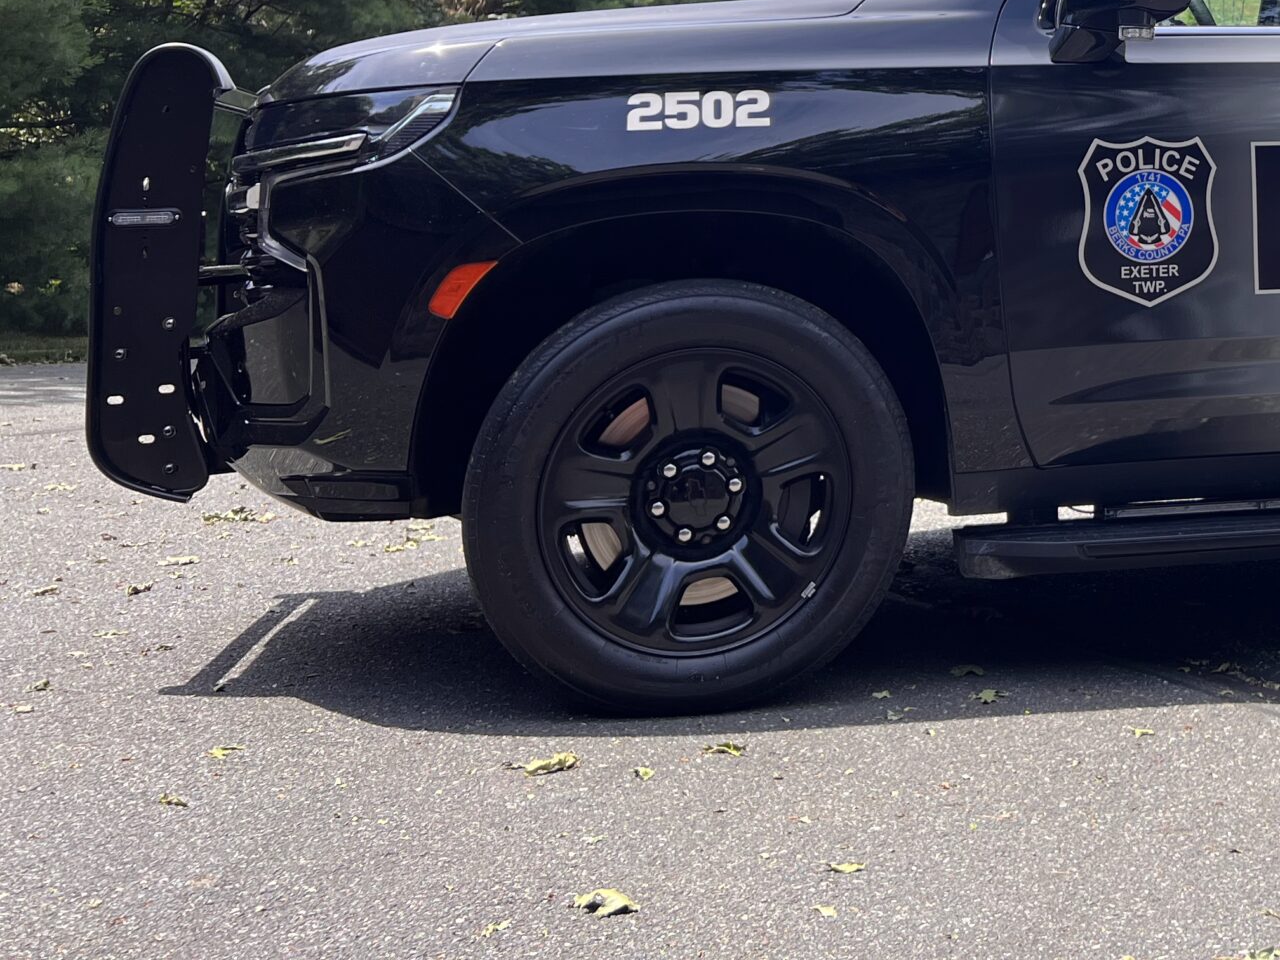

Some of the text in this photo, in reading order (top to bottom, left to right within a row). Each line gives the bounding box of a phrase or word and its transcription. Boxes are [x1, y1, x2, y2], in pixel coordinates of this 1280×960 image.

[626, 89, 771, 132] 2502
[1095, 148, 1201, 182] POLICE
[1135, 172, 1161, 183] 1741
[1108, 223, 1190, 260] BERKS COUNTY, PA
[1120, 264, 1179, 279] EXETER
[1132, 280, 1168, 294] TWP.
